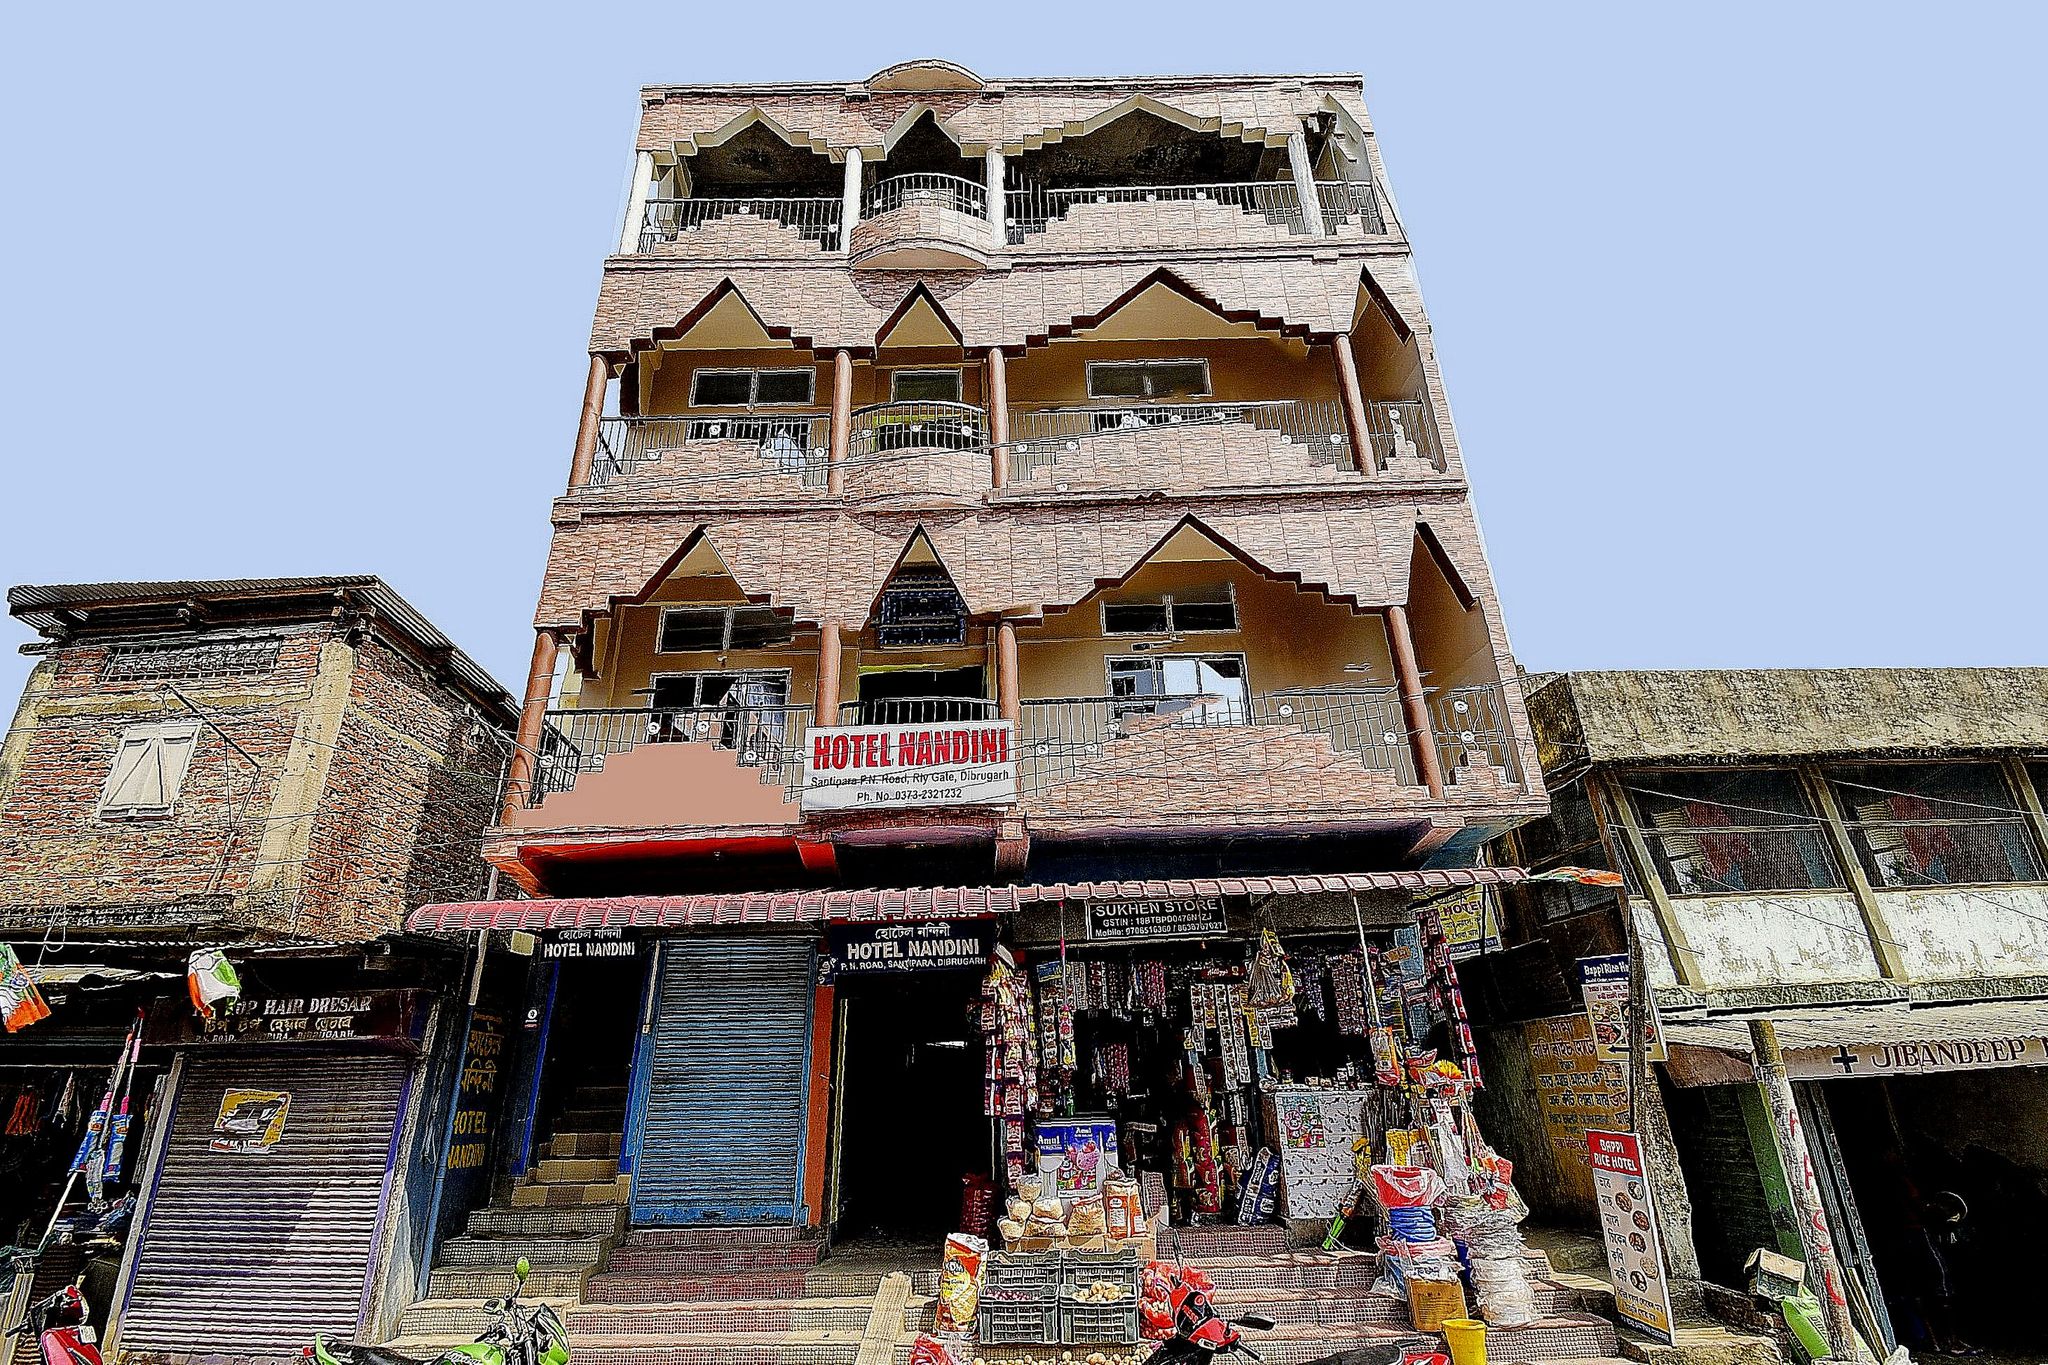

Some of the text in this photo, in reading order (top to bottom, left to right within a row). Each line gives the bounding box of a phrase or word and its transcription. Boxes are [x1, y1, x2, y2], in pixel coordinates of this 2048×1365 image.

[813, 728, 1008, 770] HOTEL NANDINI
[811, 775, 857, 789] Santipara
[882, 773, 909, 786] Road,
[912, 772, 929, 786] Rly
[931, 771, 957, 784] Gate,
[960, 769, 1009, 783] Dibrugarh
[857, 791, 873, 802] Ph.
[895, 788, 962, 800] 0373-2321232
[1095, 899, 1218, 917] SUKHEN STORE
[876, 921, 951, 940] হোটেল নন্দিনী
[1103, 918, 1128, 928] GSTIN
[558, 928, 592, 941] হোটেল
[1095, 928, 1124, 938] Mobile:
[544, 941, 635, 958] HOTEL NANDINI
[847, 938, 979, 960] HOTEL NANDINI
[860, 959, 887, 971] ROAD,
[938, 956, 987, 967] DIBRUGARH
[1603, 963, 1620, 974] Rice
[263, 998, 304, 1016] HAIR
[308, 996, 372, 1014] DRESAR
[1871, 1037, 2026, 1068] JIBANDEEP
[1037, 1135, 1060, 1145] Amul
[1600, 1139, 1625, 1154] BAPPI
[1593, 1152, 1610, 1167] RICE
[1611, 1156, 1638, 1172] HOTEL
